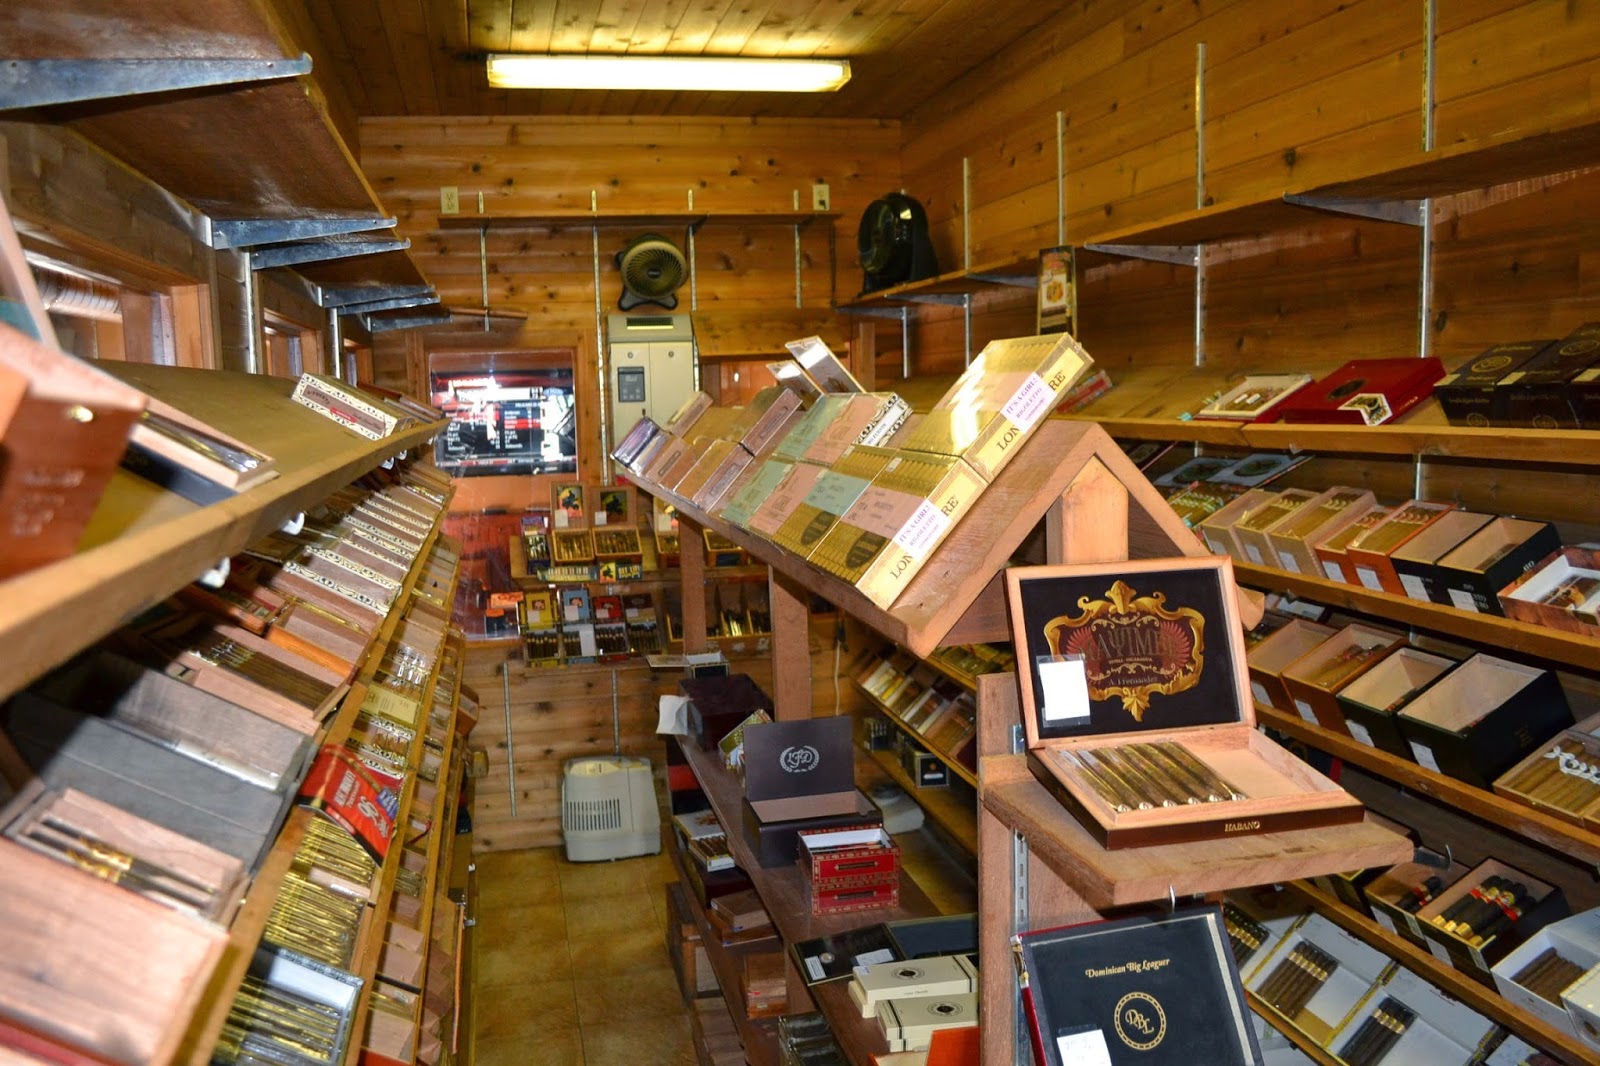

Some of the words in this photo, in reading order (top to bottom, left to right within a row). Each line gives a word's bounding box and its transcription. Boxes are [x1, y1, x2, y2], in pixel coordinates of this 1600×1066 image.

[1016, 387, 1043, 418] RIGOLETTO
[909, 514, 936, 547] RIGOLETTO
[788, 752, 812, 768] LFD
[1225, 821, 1260, 832] HABANO
[1085, 965, 1126, 978] Dominican
[1126, 961, 1143, 974] Big
[1141, 958, 1171, 971] Leaguer
[1125, 1009, 1154, 1035] DBL
